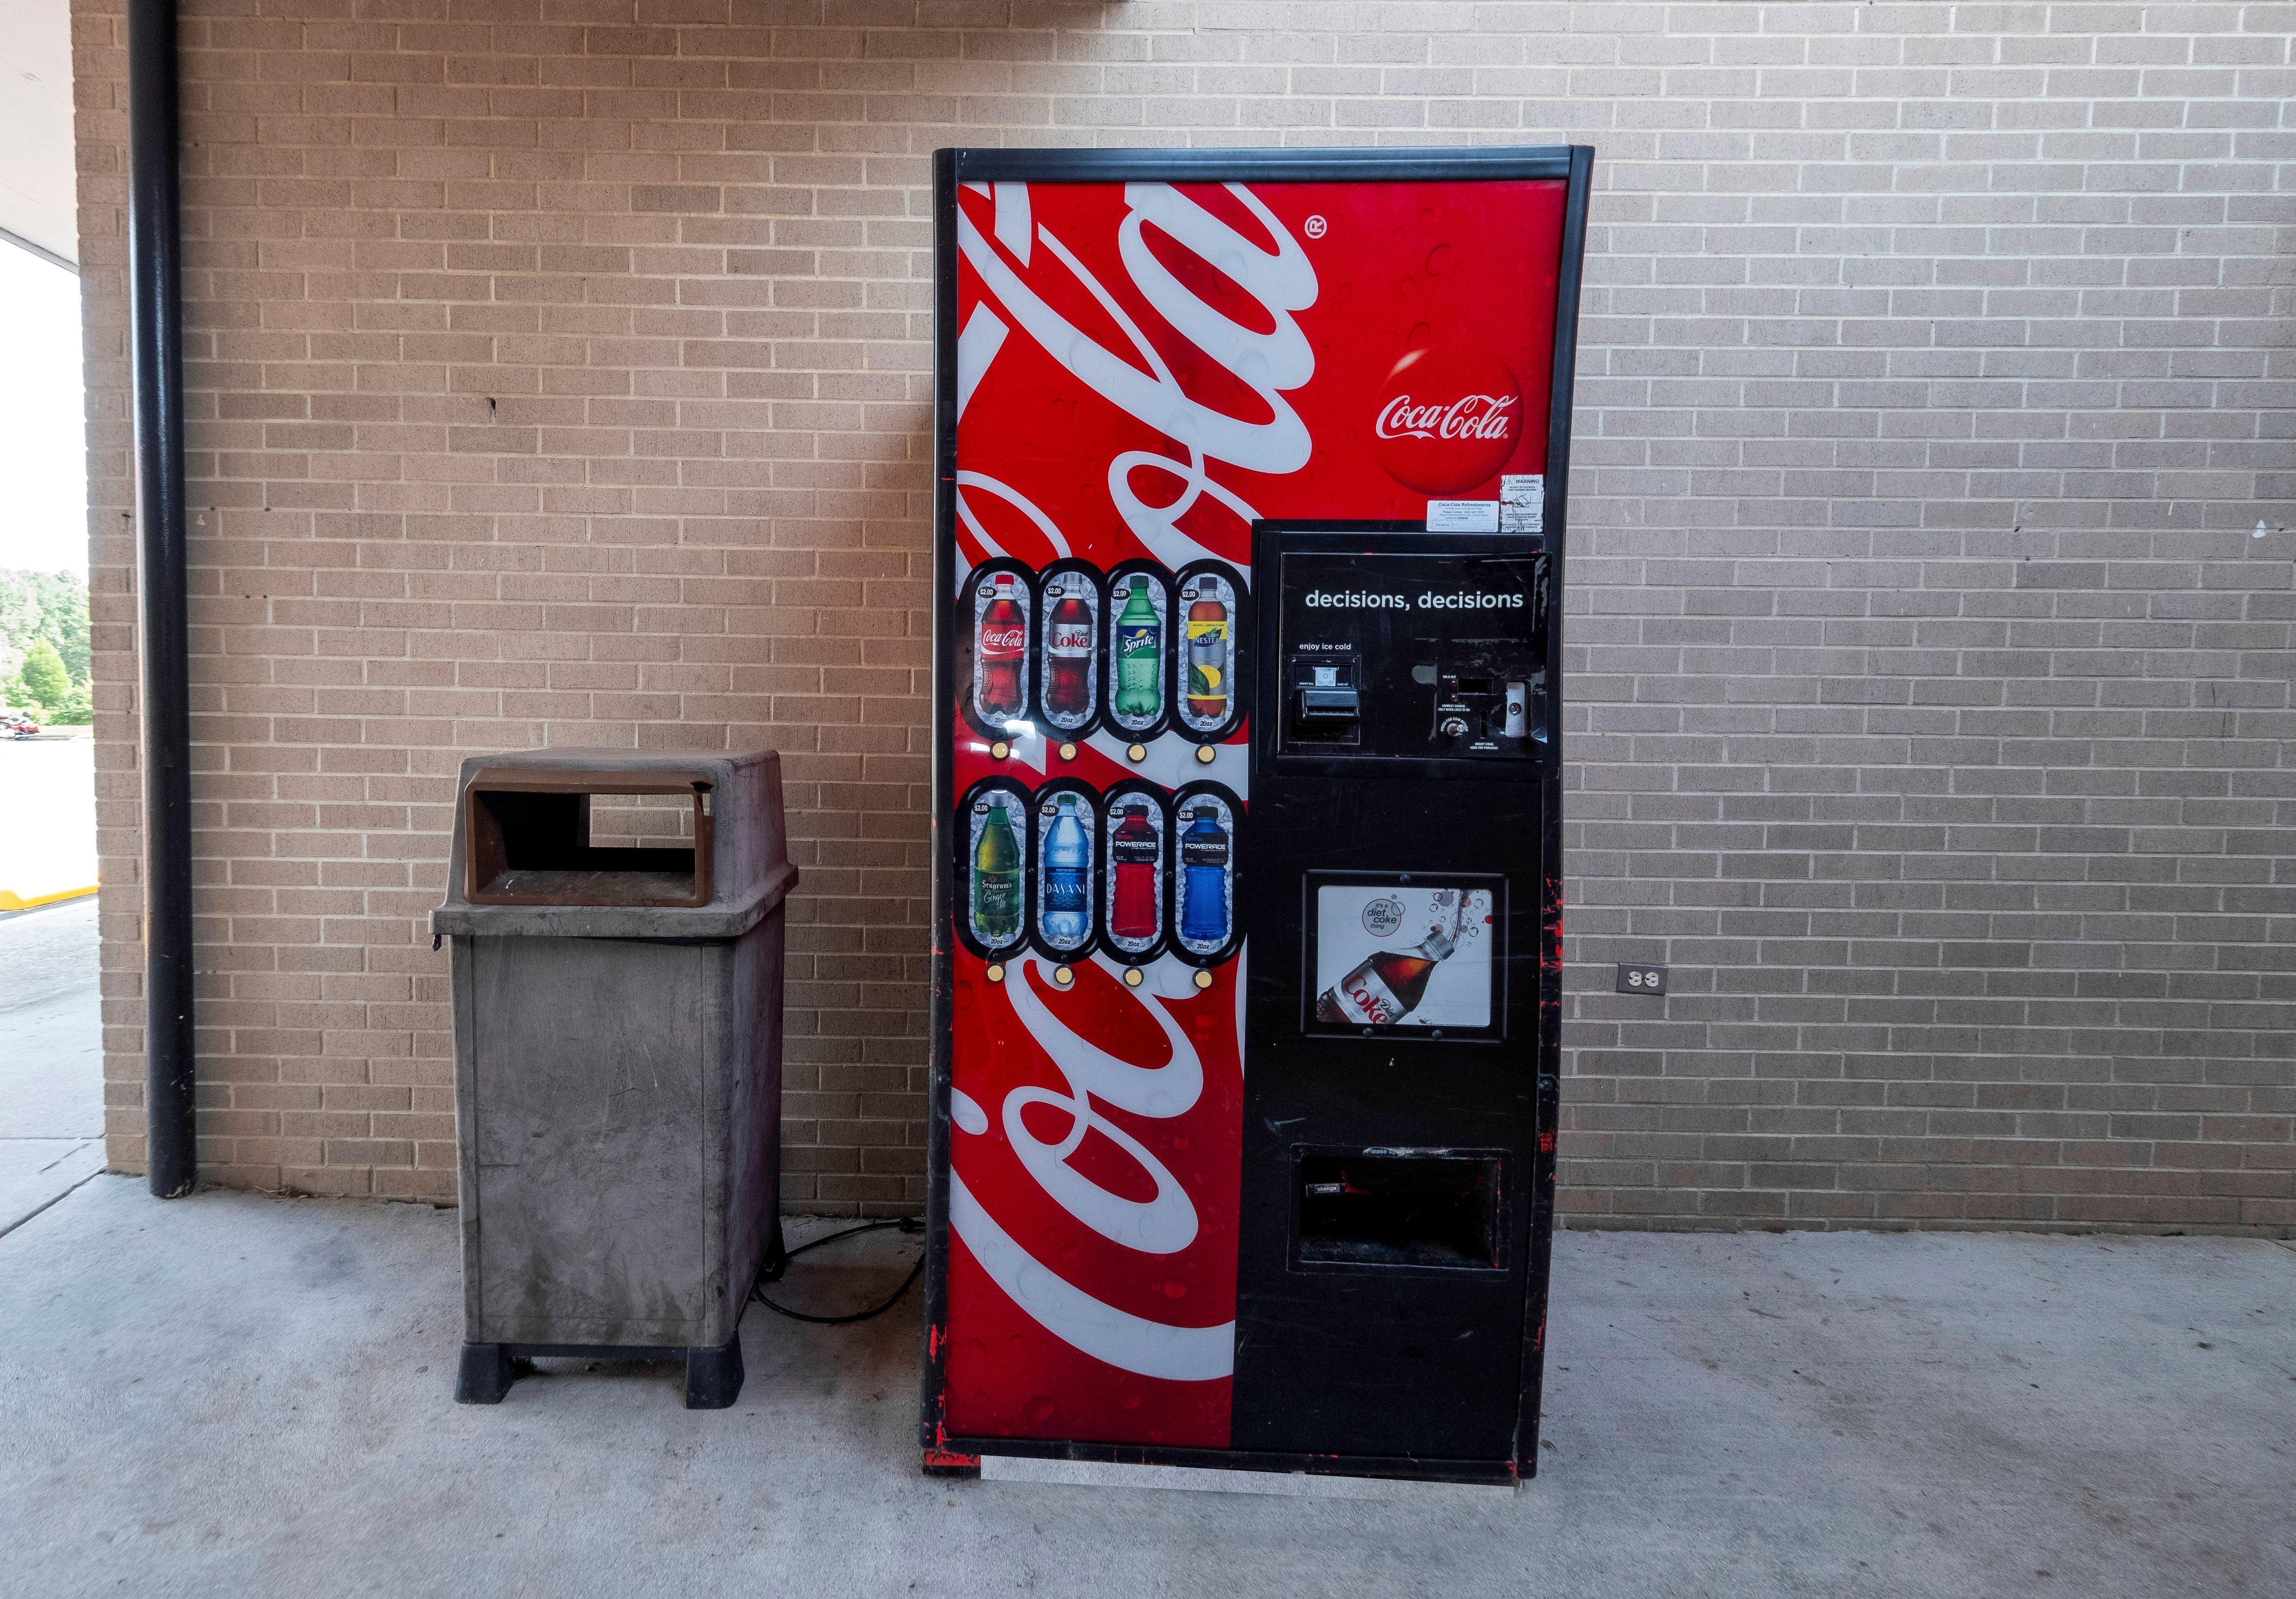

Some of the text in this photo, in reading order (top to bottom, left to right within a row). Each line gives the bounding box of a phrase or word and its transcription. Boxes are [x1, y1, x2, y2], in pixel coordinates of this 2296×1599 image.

[1376, 395, 1518, 439] Coca-Cola
[1306, 590, 1524, 611] decisions, decisions
[983, 630, 1023, 647] Coca-Cola
[1052, 632, 1088, 648] Coke
[1124, 635, 1154, 654] Sprite
[1194, 636, 1221, 644] NESTEA
[982, 880, 1013, 890] Seagram's
[1047, 881, 1085, 896] DASANI
[984, 892, 1006, 906] Ginger
[1367, 908, 1386, 917] diet
[1373, 916, 1397, 924] coke
[1345, 976, 1388, 1024] Coke
[1379, 998, 1397, 1018] Diet
